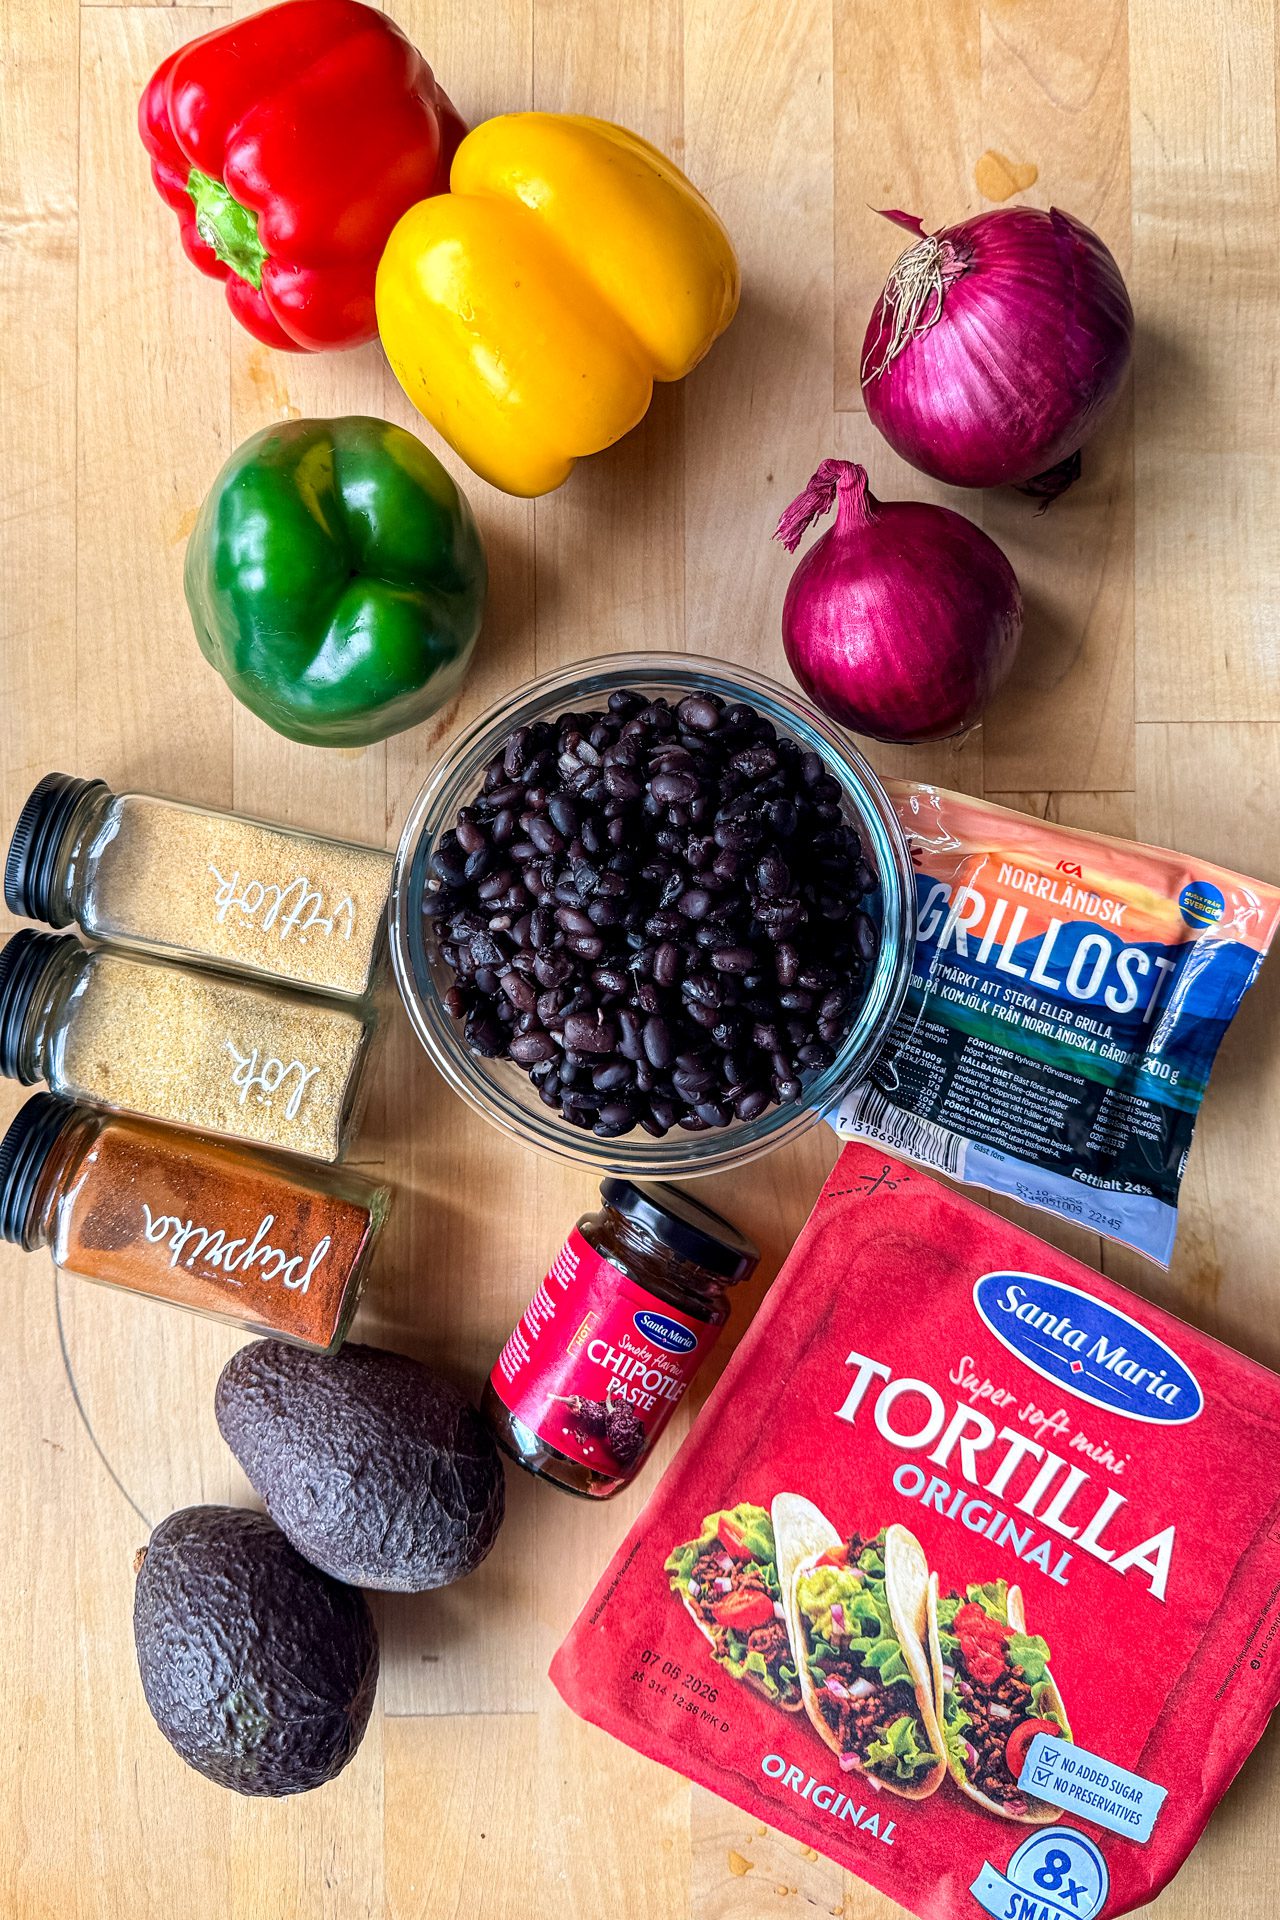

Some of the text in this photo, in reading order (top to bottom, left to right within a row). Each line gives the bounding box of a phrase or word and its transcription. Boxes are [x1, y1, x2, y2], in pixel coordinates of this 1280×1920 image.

[1055, 857, 1085, 879] ICA
[998, 863, 1127, 926] NORRLÄNDSK
[918, 883, 1176, 1023] GRILLOST
[923, 976, 940, 995] PÅ
[940, 984, 989, 1014] KOMJÖLK
[991, 1005, 1020, 1025] FRÅN
[1022, 1014, 1096, 1054] NORRLÄNDSKA
[929, 961, 1116, 1040] UTMÄRKT ATT STEKA ELLER GRILLA.
[904, 1043, 921, 1055] PER
[924, 1031, 948, 1044] enzym
[963, 1045, 984, 1058] högst
[966, 1036, 1014, 1059] FÖRVARING
[1013, 1054, 1042, 1070] Kylvara.
[1041, 1064, 1072, 1082] Förvaras
[224, 1039, 322, 1120] lök
[955, 1064, 1069, 1111] märkning. Bäst före-datum gäller
[959, 1054, 1013, 1079] HÅLLBARHET
[1012, 1074, 1029, 1086] Bäst
[1139, 1055, 1180, 1085] 200 g
[946, 1089, 972, 1105] längre.
[990, 1105, 1009, 1118] lukta
[1008, 1112, 1023, 1123] och
[1022, 1118, 1048, 1132] smaka!
[950, 1081, 965, 1091] Mat
[964, 1087, 980, 1097] som
[980, 1092, 1010, 1108] förvaras
[1042, 1116, 1064, 1129] oftast
[953, 1072, 1064, 1120] endast för oöppnad förpackning.
[1133, 1107, 1162, 1123] Sverige
[837, 1117, 847, 1129] 7
[853, 1121, 903, 1148] 318690
[936, 1115, 966, 1131] Sorteras
[965, 1127, 981, 1136] som
[943, 1098, 1000, 1125] FÖRPACKNING
[999, 1120, 1050, 1145] Förpackningen
[965, 1117, 990, 1131] sorters
[989, 1126, 1008, 1139] plast
[1008, 1133, 1025, 1144] utan
[972, 1143, 1005, 1161] Bäst före
[1070, 1167, 1154, 1197] Fetthalt 24%
[1086, 1210, 1123, 1231] 22:45
[618, 1334, 653, 1364] Smoky
[641, 1314, 693, 1349] Santa Maria
[996, 1285, 1181, 1405] Santa Maria
[587, 1339, 686, 1402] CHIPOTLE
[607, 1376, 657, 1412] PASTE
[949, 1356, 1131, 1476] Super soft mini
[834, 1350, 1179, 1602] TORTILLA
[893, 1463, 1076, 1586] ORIGINAL
[641, 1650, 718, 1703] 07 05 2026
[672, 1694, 699, 1715] 12:56
[761, 1754, 898, 1845] ORIGINAL
[1052, 1776, 1143, 1826] NO PRESERVATIVES
[1059, 1757, 1143, 1804] NO ADDED SUGAR
[1033, 1849, 1088, 1908] 8x
